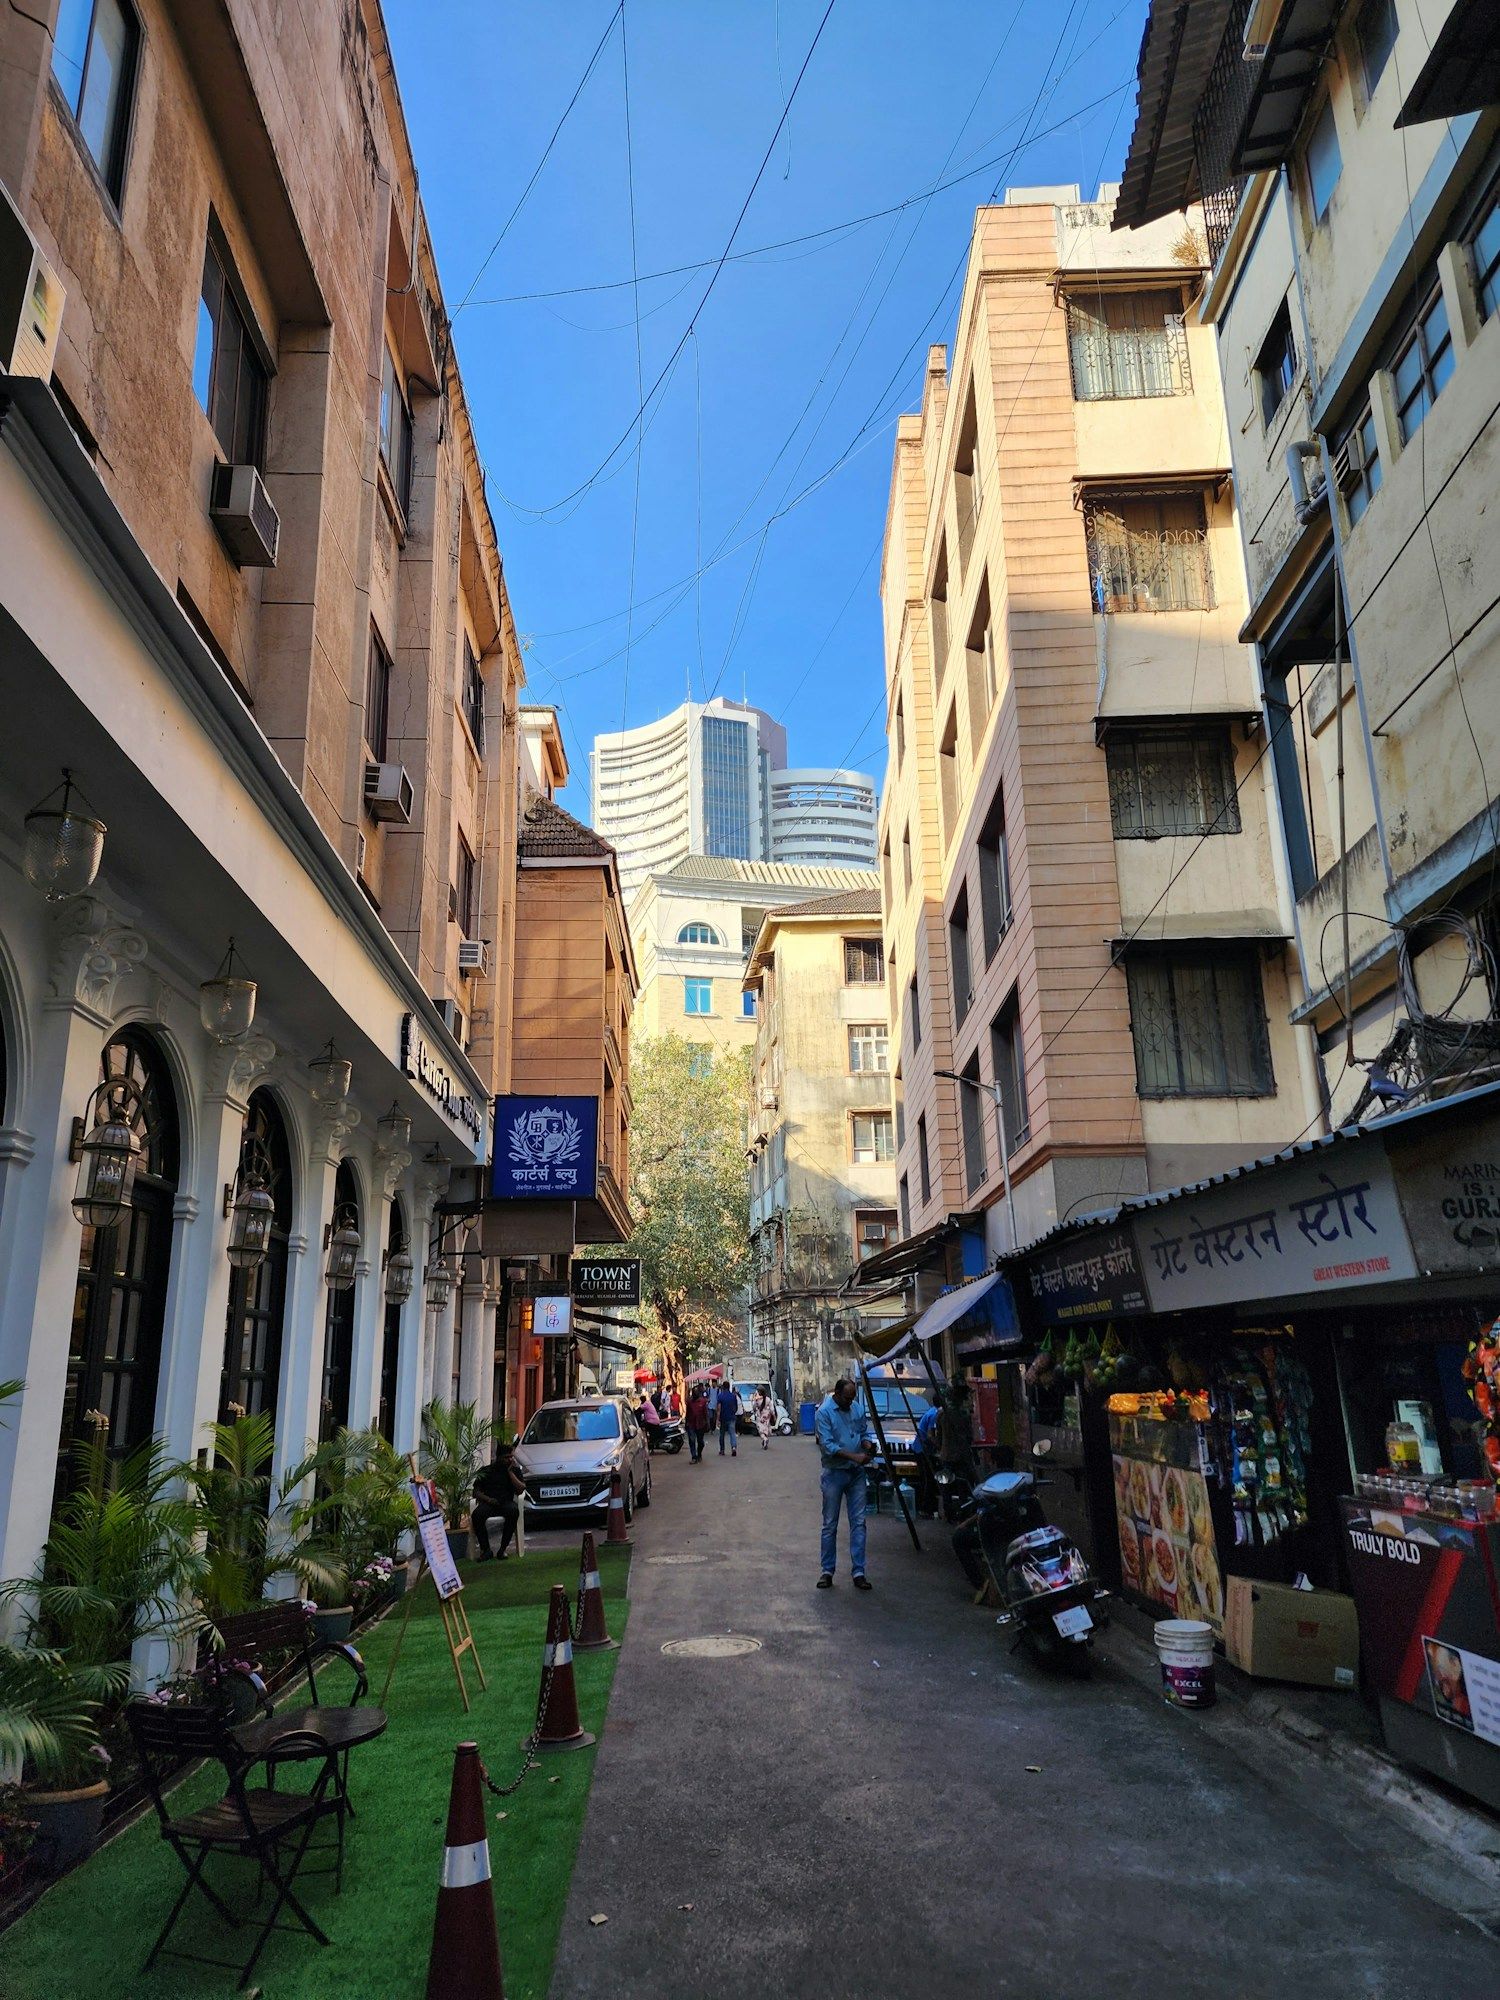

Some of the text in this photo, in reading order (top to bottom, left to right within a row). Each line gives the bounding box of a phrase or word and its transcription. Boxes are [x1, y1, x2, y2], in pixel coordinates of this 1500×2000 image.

[511, 1164, 578, 1184] कार्टर्स ब्ल्यु
[1150, 1173, 1378, 1280] ग्रेट वेस्टरन स्टोर
[580, 1267, 631, 1281] TOWN
[1313, 1256, 1391, 1281] GREAT WESTERN STORE
[580, 1280, 631, 1291] CULTURE
[1349, 1530, 1421, 1565] TRULY BOLD
[1174, 1679, 1203, 1687] EXCEL
